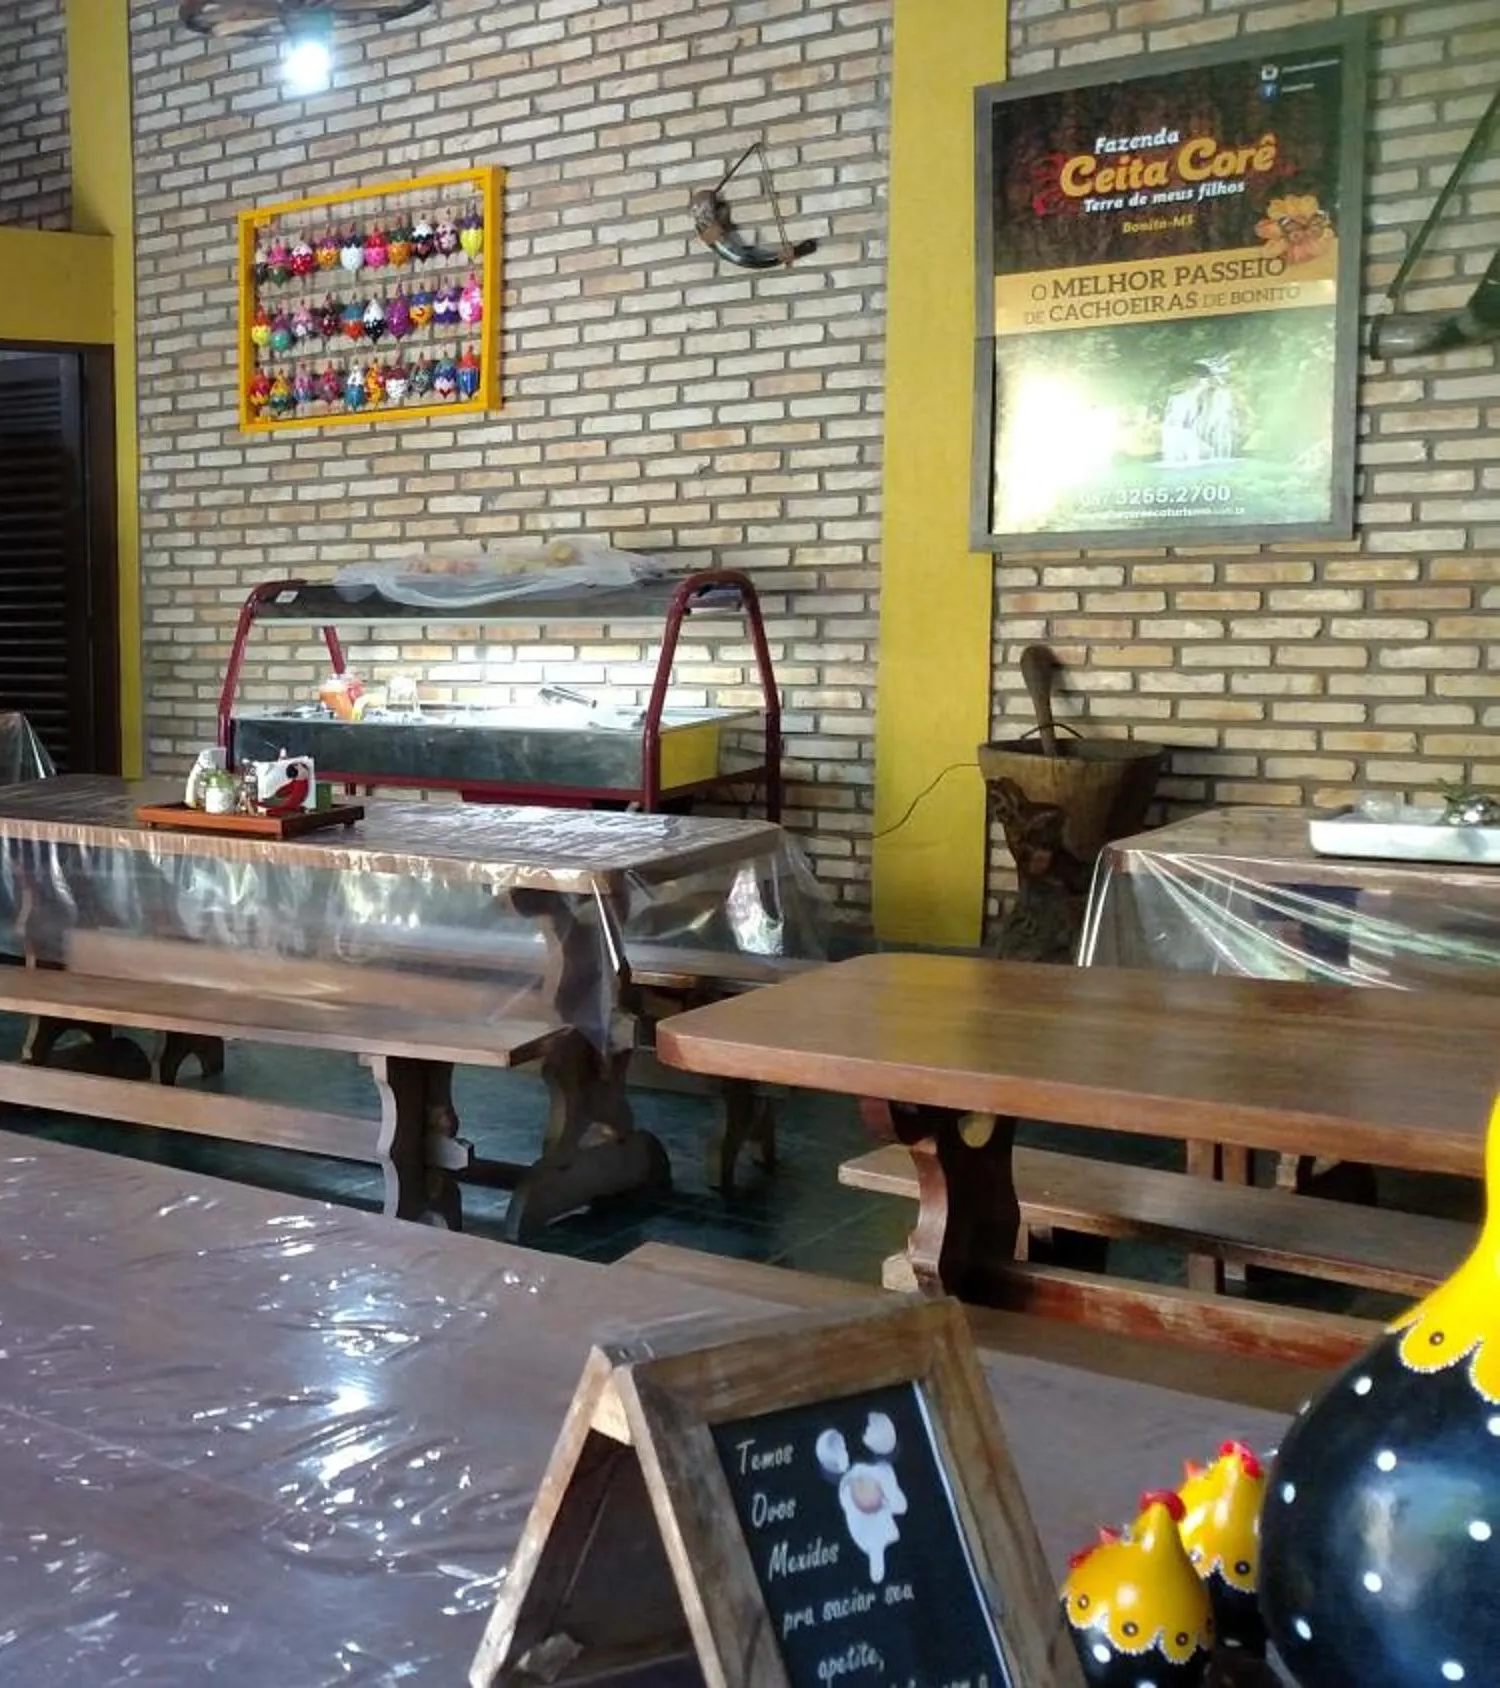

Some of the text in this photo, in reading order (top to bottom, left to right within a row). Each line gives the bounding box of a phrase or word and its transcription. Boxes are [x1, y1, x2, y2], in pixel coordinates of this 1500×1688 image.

[1094, 127, 1180, 155] Fazenda
[1059, 132, 1278, 197] Ceita Corê
[1083, 179, 1246, 214] Terra de meus filhos
[1052, 268, 1167, 300] MELHOR
[1174, 255, 1287, 287] PASSEIO
[1024, 286, 1302, 326] DE CACHOEIRAS DE BONITO
[736, 1439, 794, 1475] Temos
[752, 1493, 797, 1528] Ovos
[768, 1536, 840, 1581] Mexidos
[783, 1606, 815, 1640] pra
[822, 1586, 877, 1621] saciar
